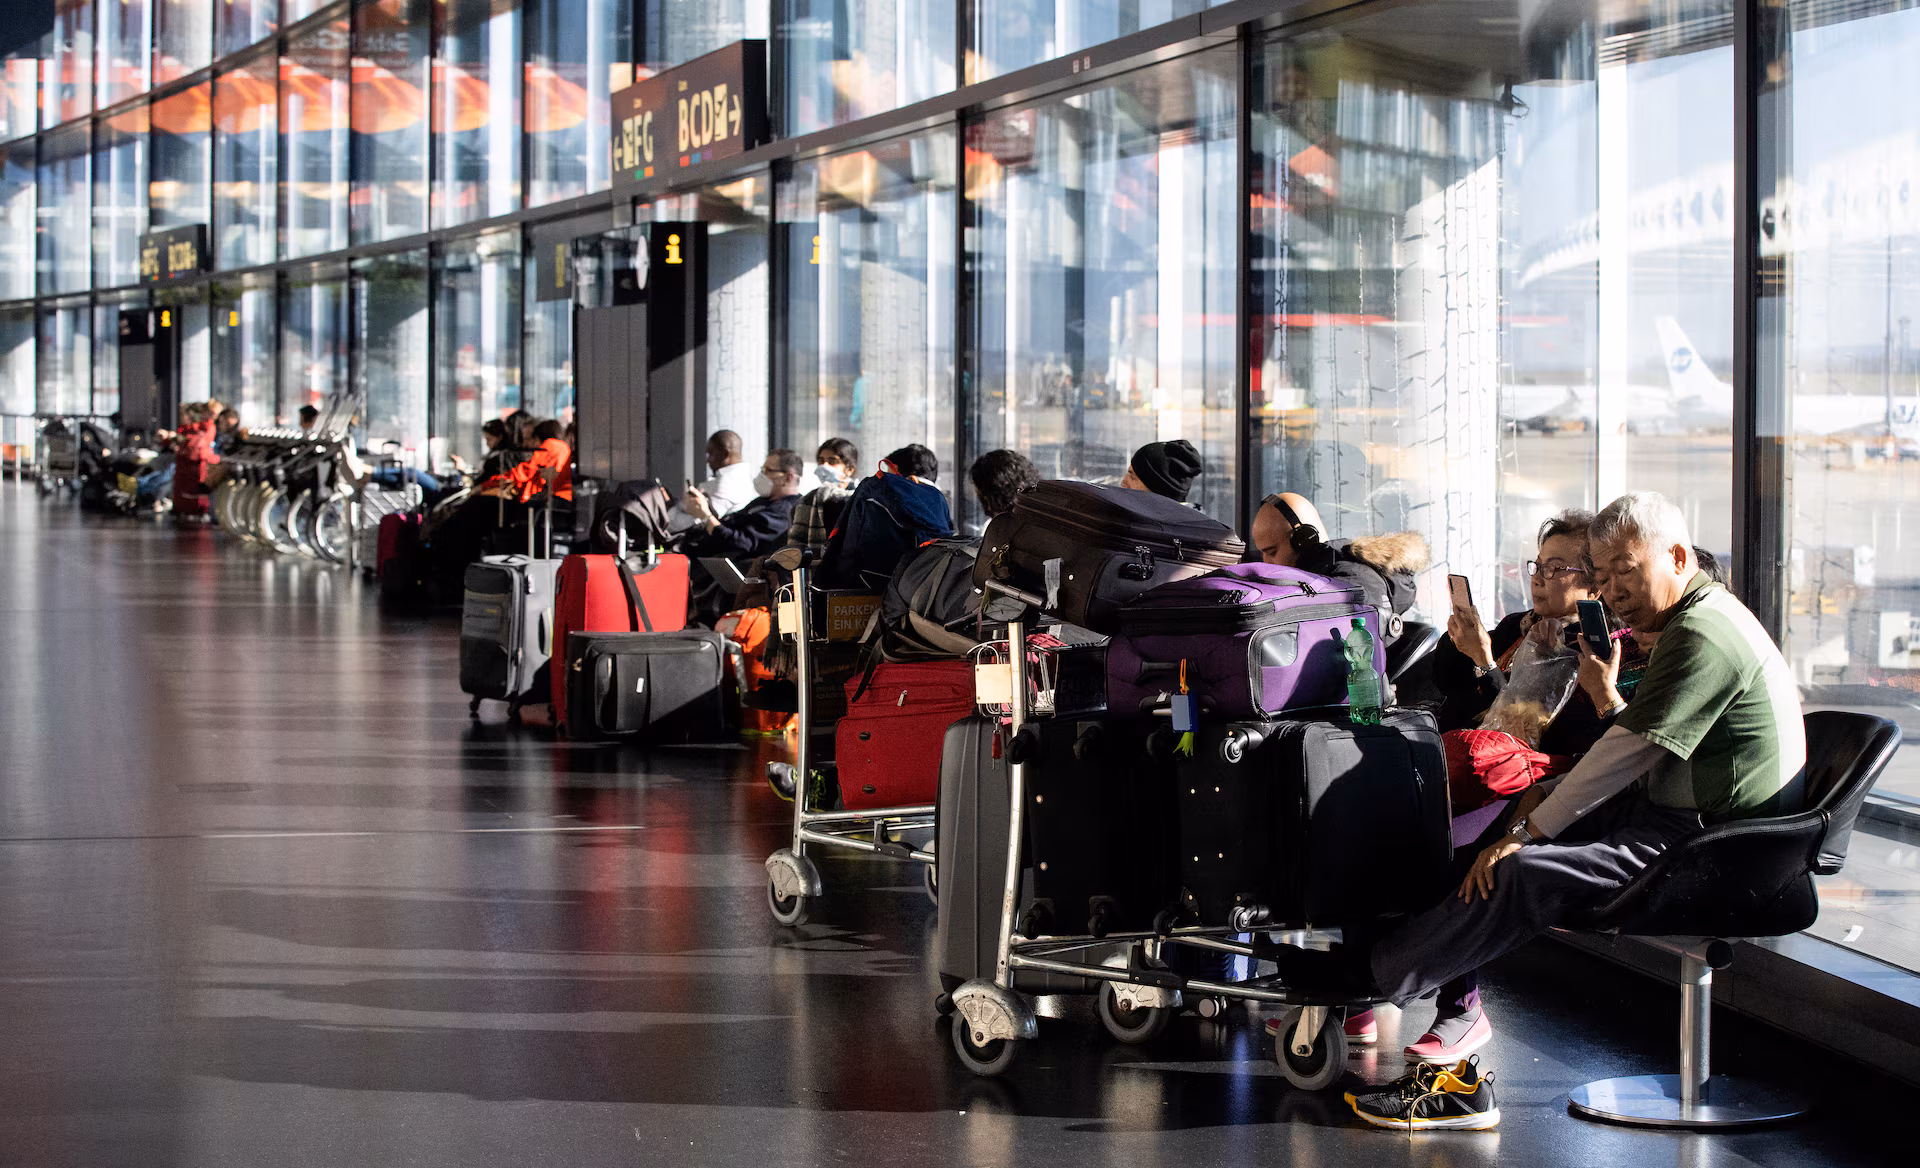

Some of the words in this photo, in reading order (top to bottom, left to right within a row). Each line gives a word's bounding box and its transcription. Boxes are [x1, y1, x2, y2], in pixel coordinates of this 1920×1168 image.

[678, 89, 714, 152] BCD
[665, 233, 683, 264] i
[834, 605, 877, 616] PARKEN
[834, 619, 852, 630] EIN
